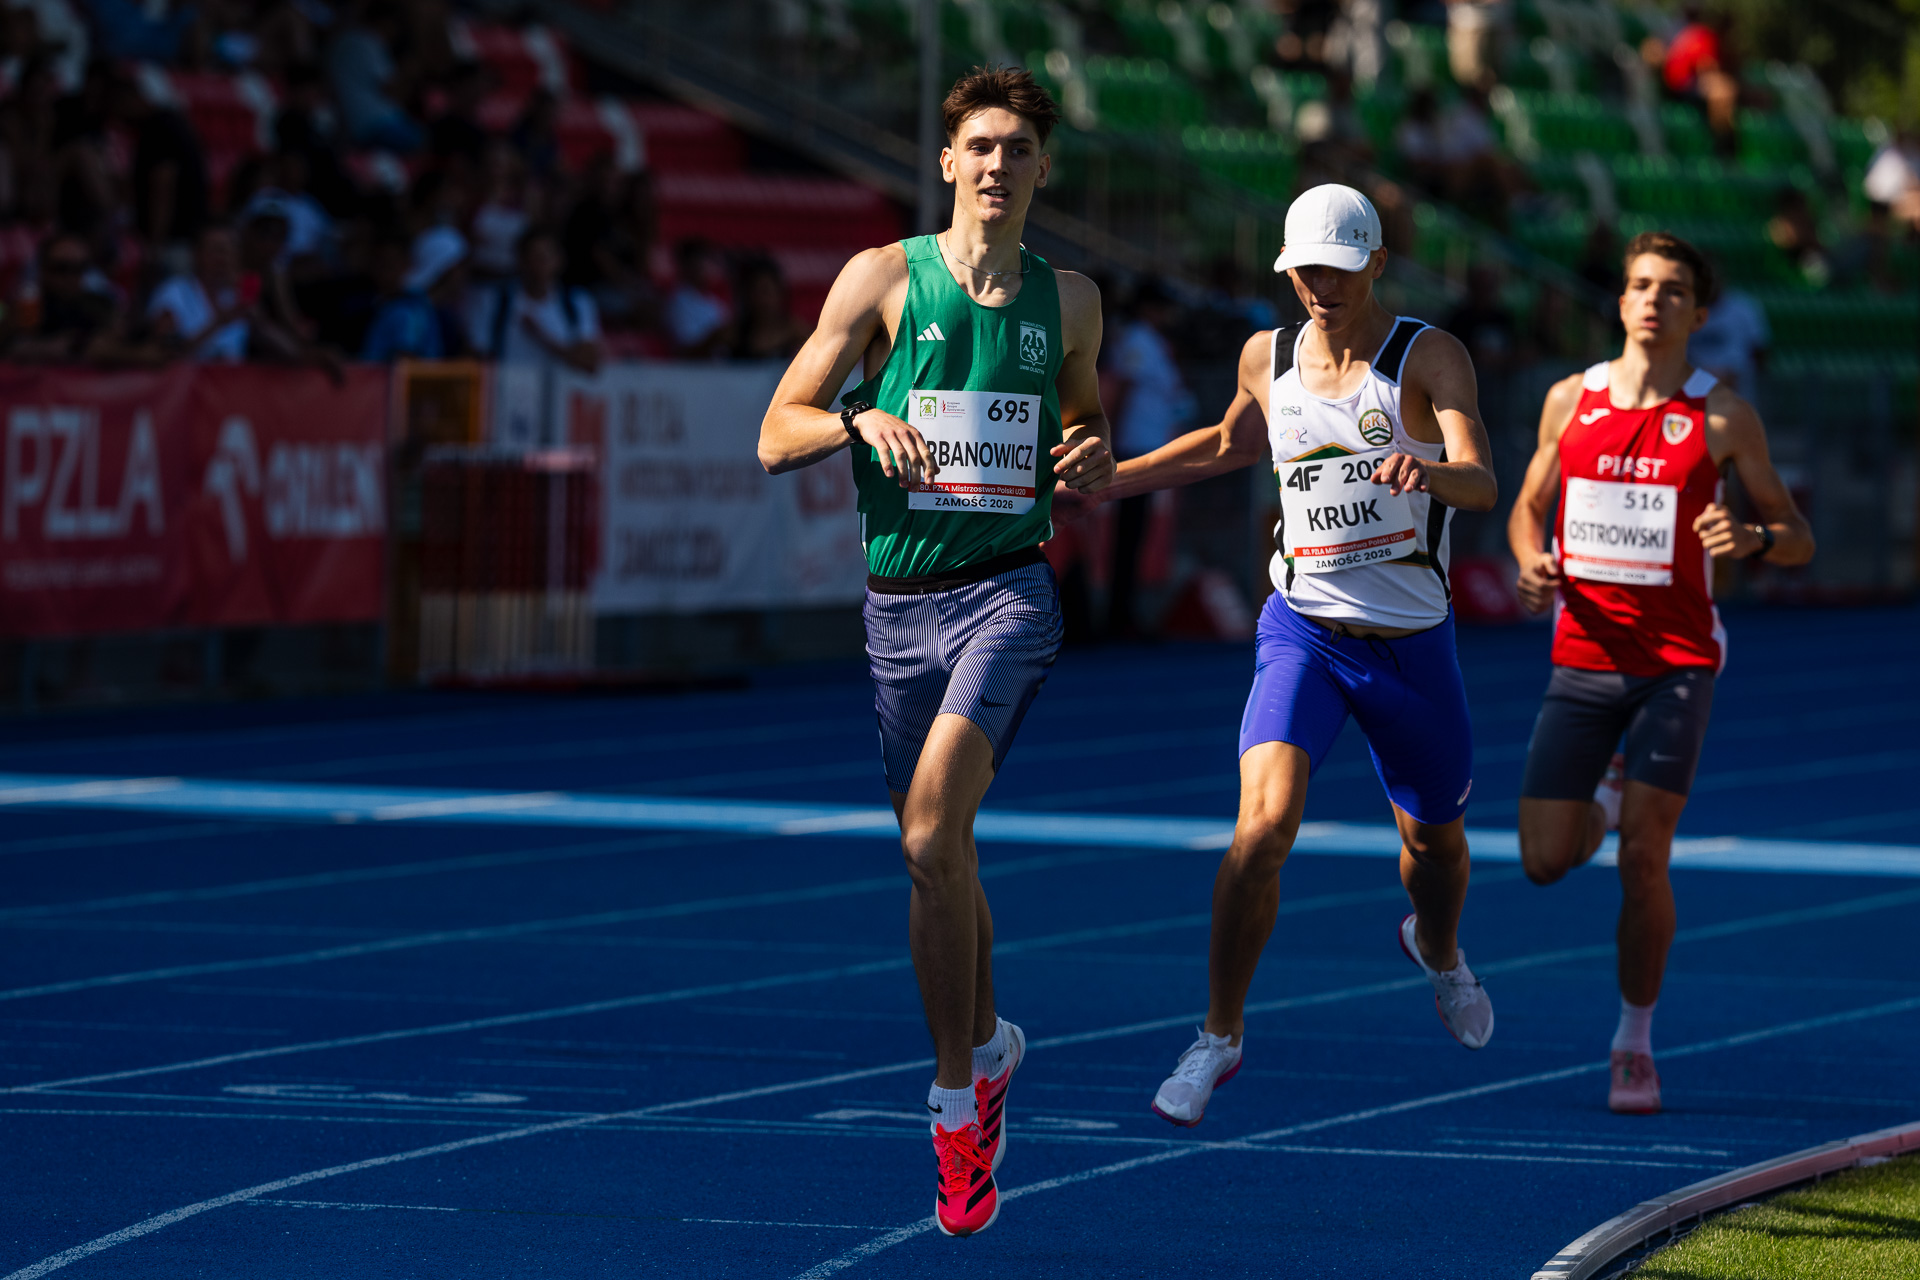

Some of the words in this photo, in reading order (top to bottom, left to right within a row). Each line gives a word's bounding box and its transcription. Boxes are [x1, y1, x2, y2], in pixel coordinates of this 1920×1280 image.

[987, 399, 1030, 424] 695
[1281, 405, 1302, 416] esa
[1363, 414, 1388, 431] RKS
[926, 440, 1034, 471] RBANOWICZ
[3, 404, 166, 541] PZLA
[1597, 454, 1667, 479] PIAST
[932, 484, 950, 492] PZLA
[951, 484, 996, 494] Mistrzostwa
[996, 487, 1015, 495] Polski
[1015, 488, 1026, 496] U20
[1624, 490, 1664, 511] 516
[935, 495, 988, 507] ZAMOŚĆ
[989, 498, 1014, 509] 2026
[1306, 498, 1382, 532] KRUK
[1325, 542, 1367, 554] Mistrzostwa
[1368, 537, 1390, 549] Polski
[1390, 533, 1405, 542] U20
[1569, 519, 1668, 549] OSTROWSKI
[1315, 552, 1362, 568] ZAMOŚĆ
[1363, 548, 1392, 561] 2026
